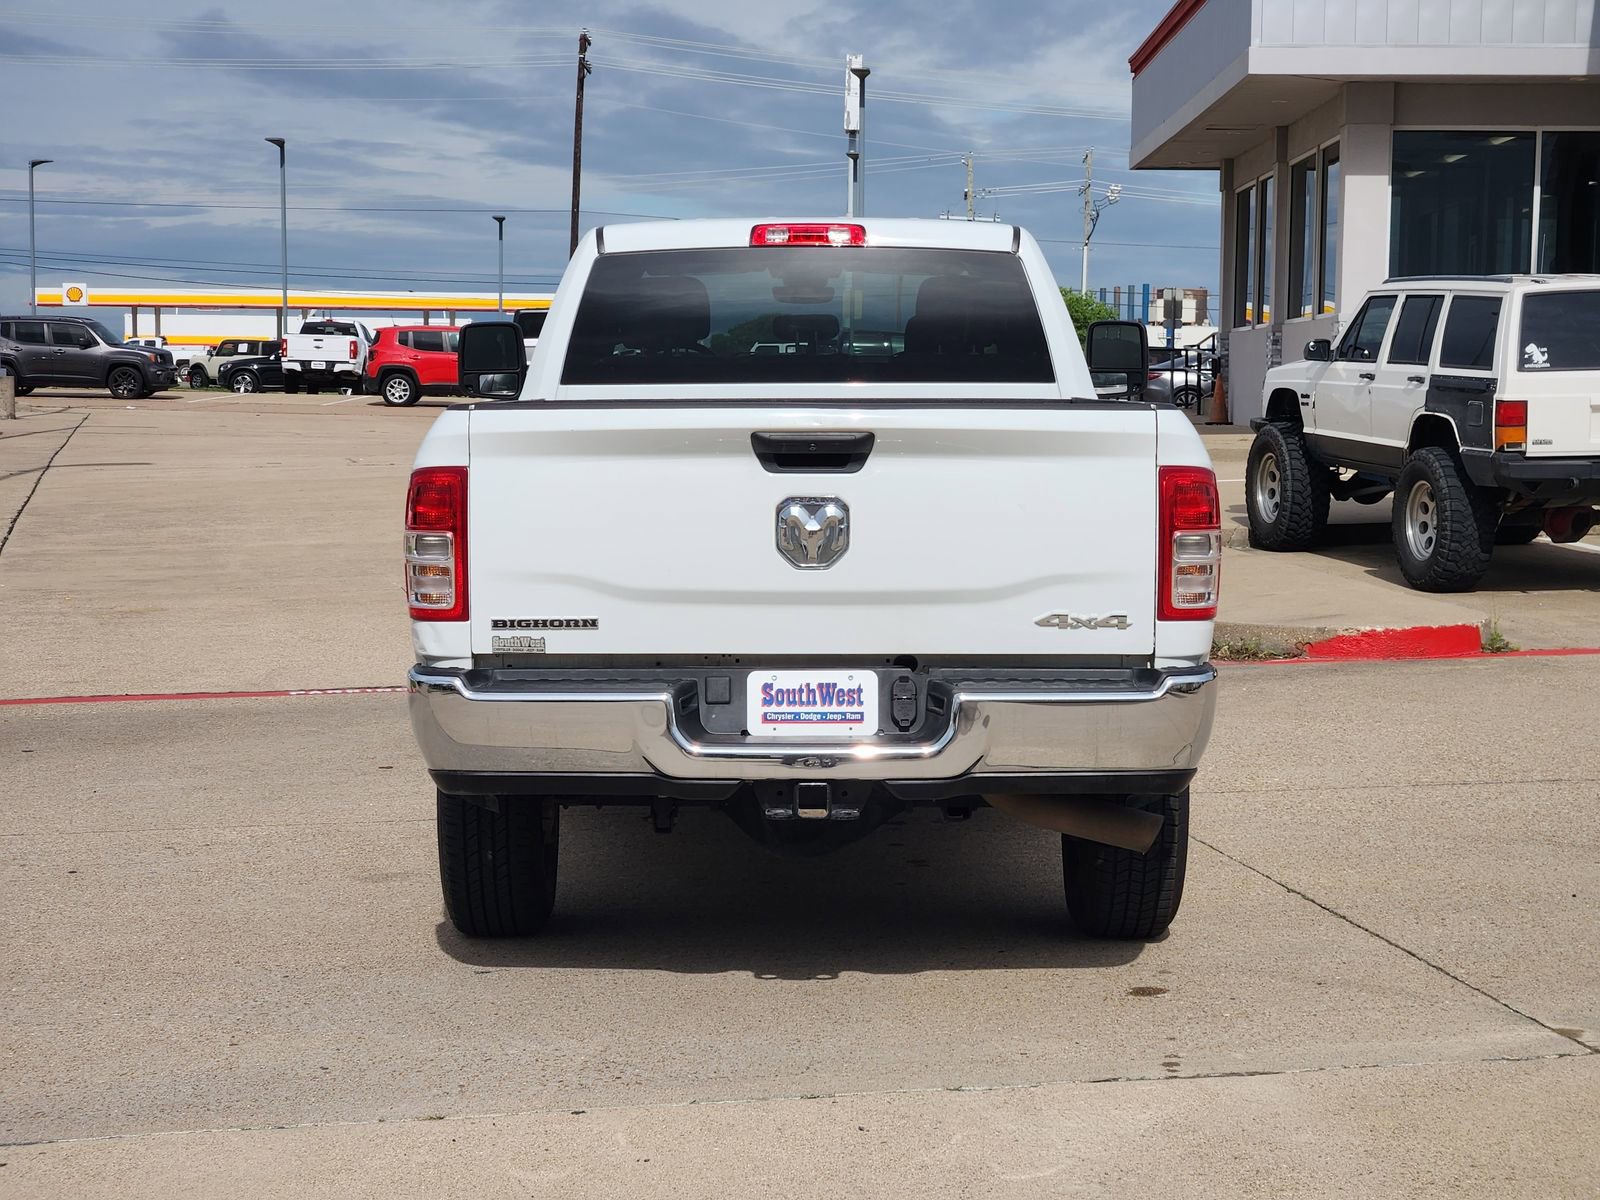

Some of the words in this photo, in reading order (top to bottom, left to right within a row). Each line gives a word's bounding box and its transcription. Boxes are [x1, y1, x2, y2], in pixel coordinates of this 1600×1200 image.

[492, 636, 545, 647] SouthWest
[761, 682, 864, 707] SouthWest
[766, 712, 795, 721] Chrysler
[800, 712, 821, 721] Dodge
[826, 712, 842, 721] Jeep
[846, 712, 861, 721] Ram
